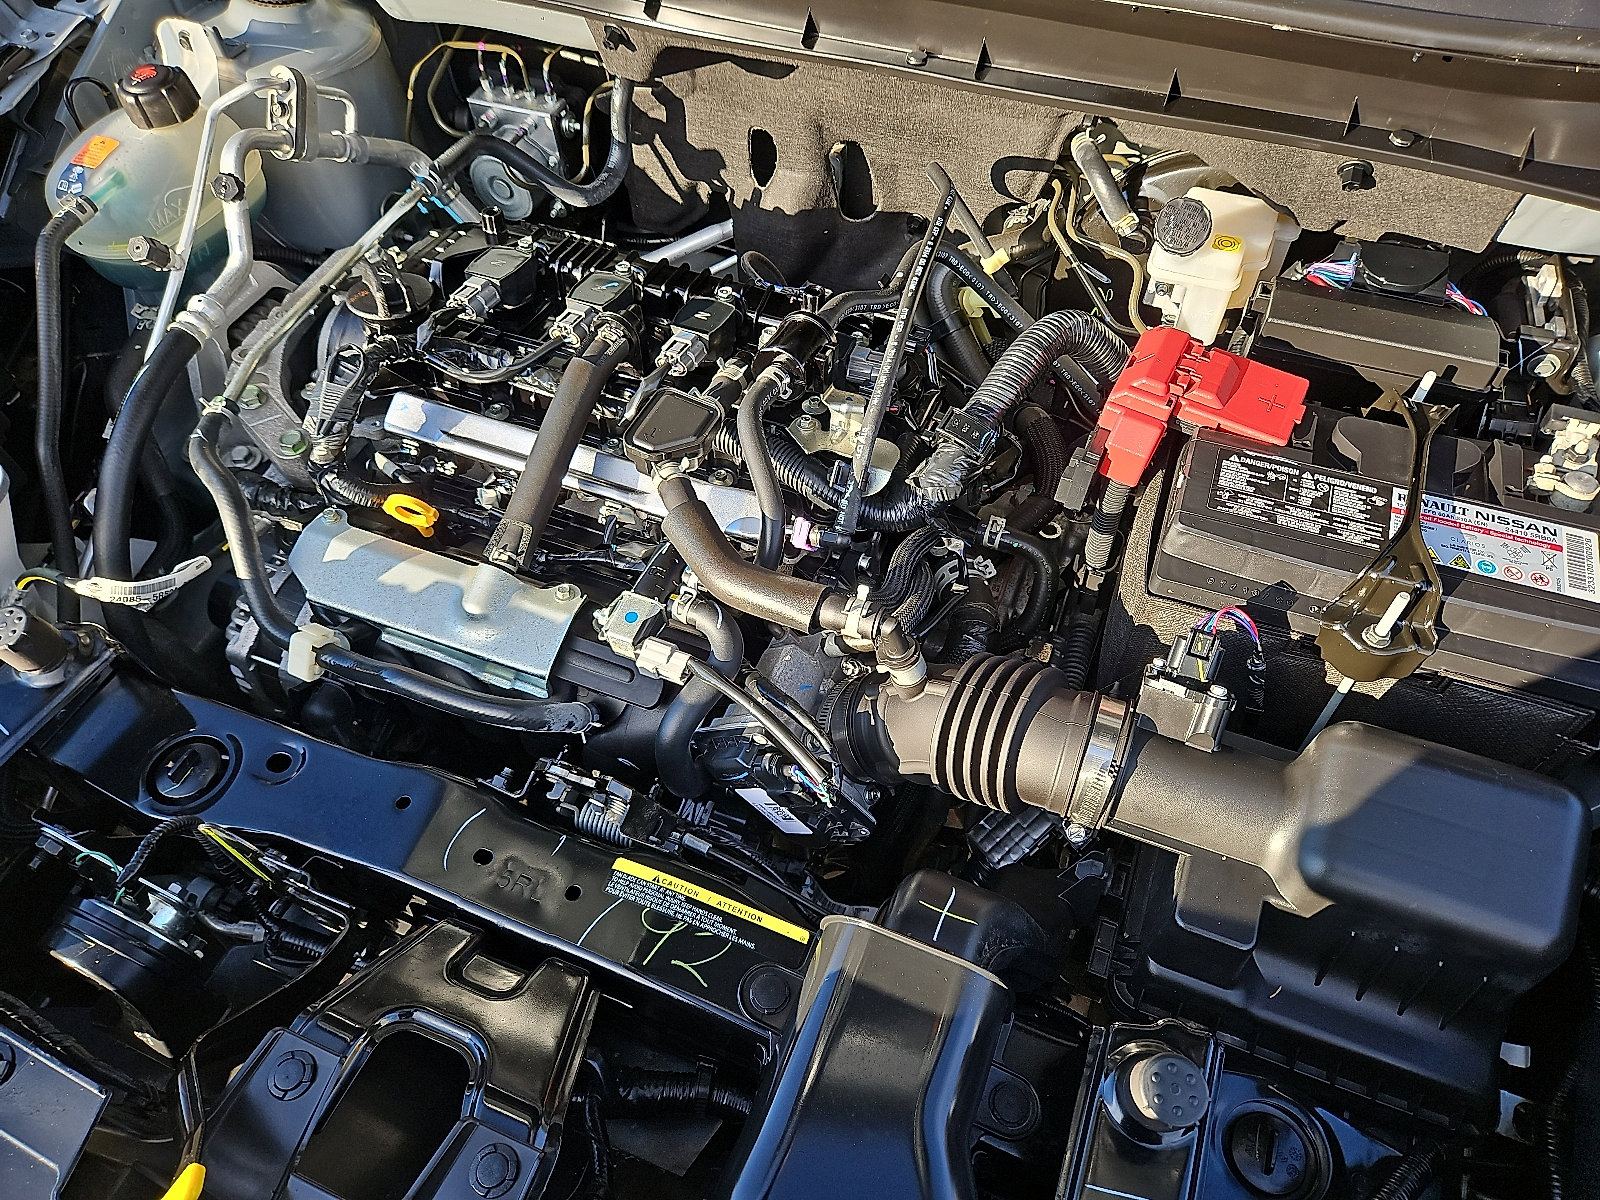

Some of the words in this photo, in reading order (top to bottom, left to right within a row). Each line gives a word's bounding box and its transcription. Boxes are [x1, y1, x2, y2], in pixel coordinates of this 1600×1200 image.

[1240, 456, 1300, 476] DANGER/POISON
[1398, 493, 1470, 516] RNAULT
[1475, 511, 1558, 537] NISSAN
[1450, 536, 1486, 549] CLARIOS
[1460, 524, 1484, 534] Battery
[1489, 530, 1514, 540] Special
[1514, 536, 1551, 549] technology
[645, 881, 658, 890] START
[662, 878, 700, 898] CAUTION
[716, 900, 763, 923] ATTENTION
[691, 905, 708, 916] HANDS
[682, 915, 692, 923] PAS
